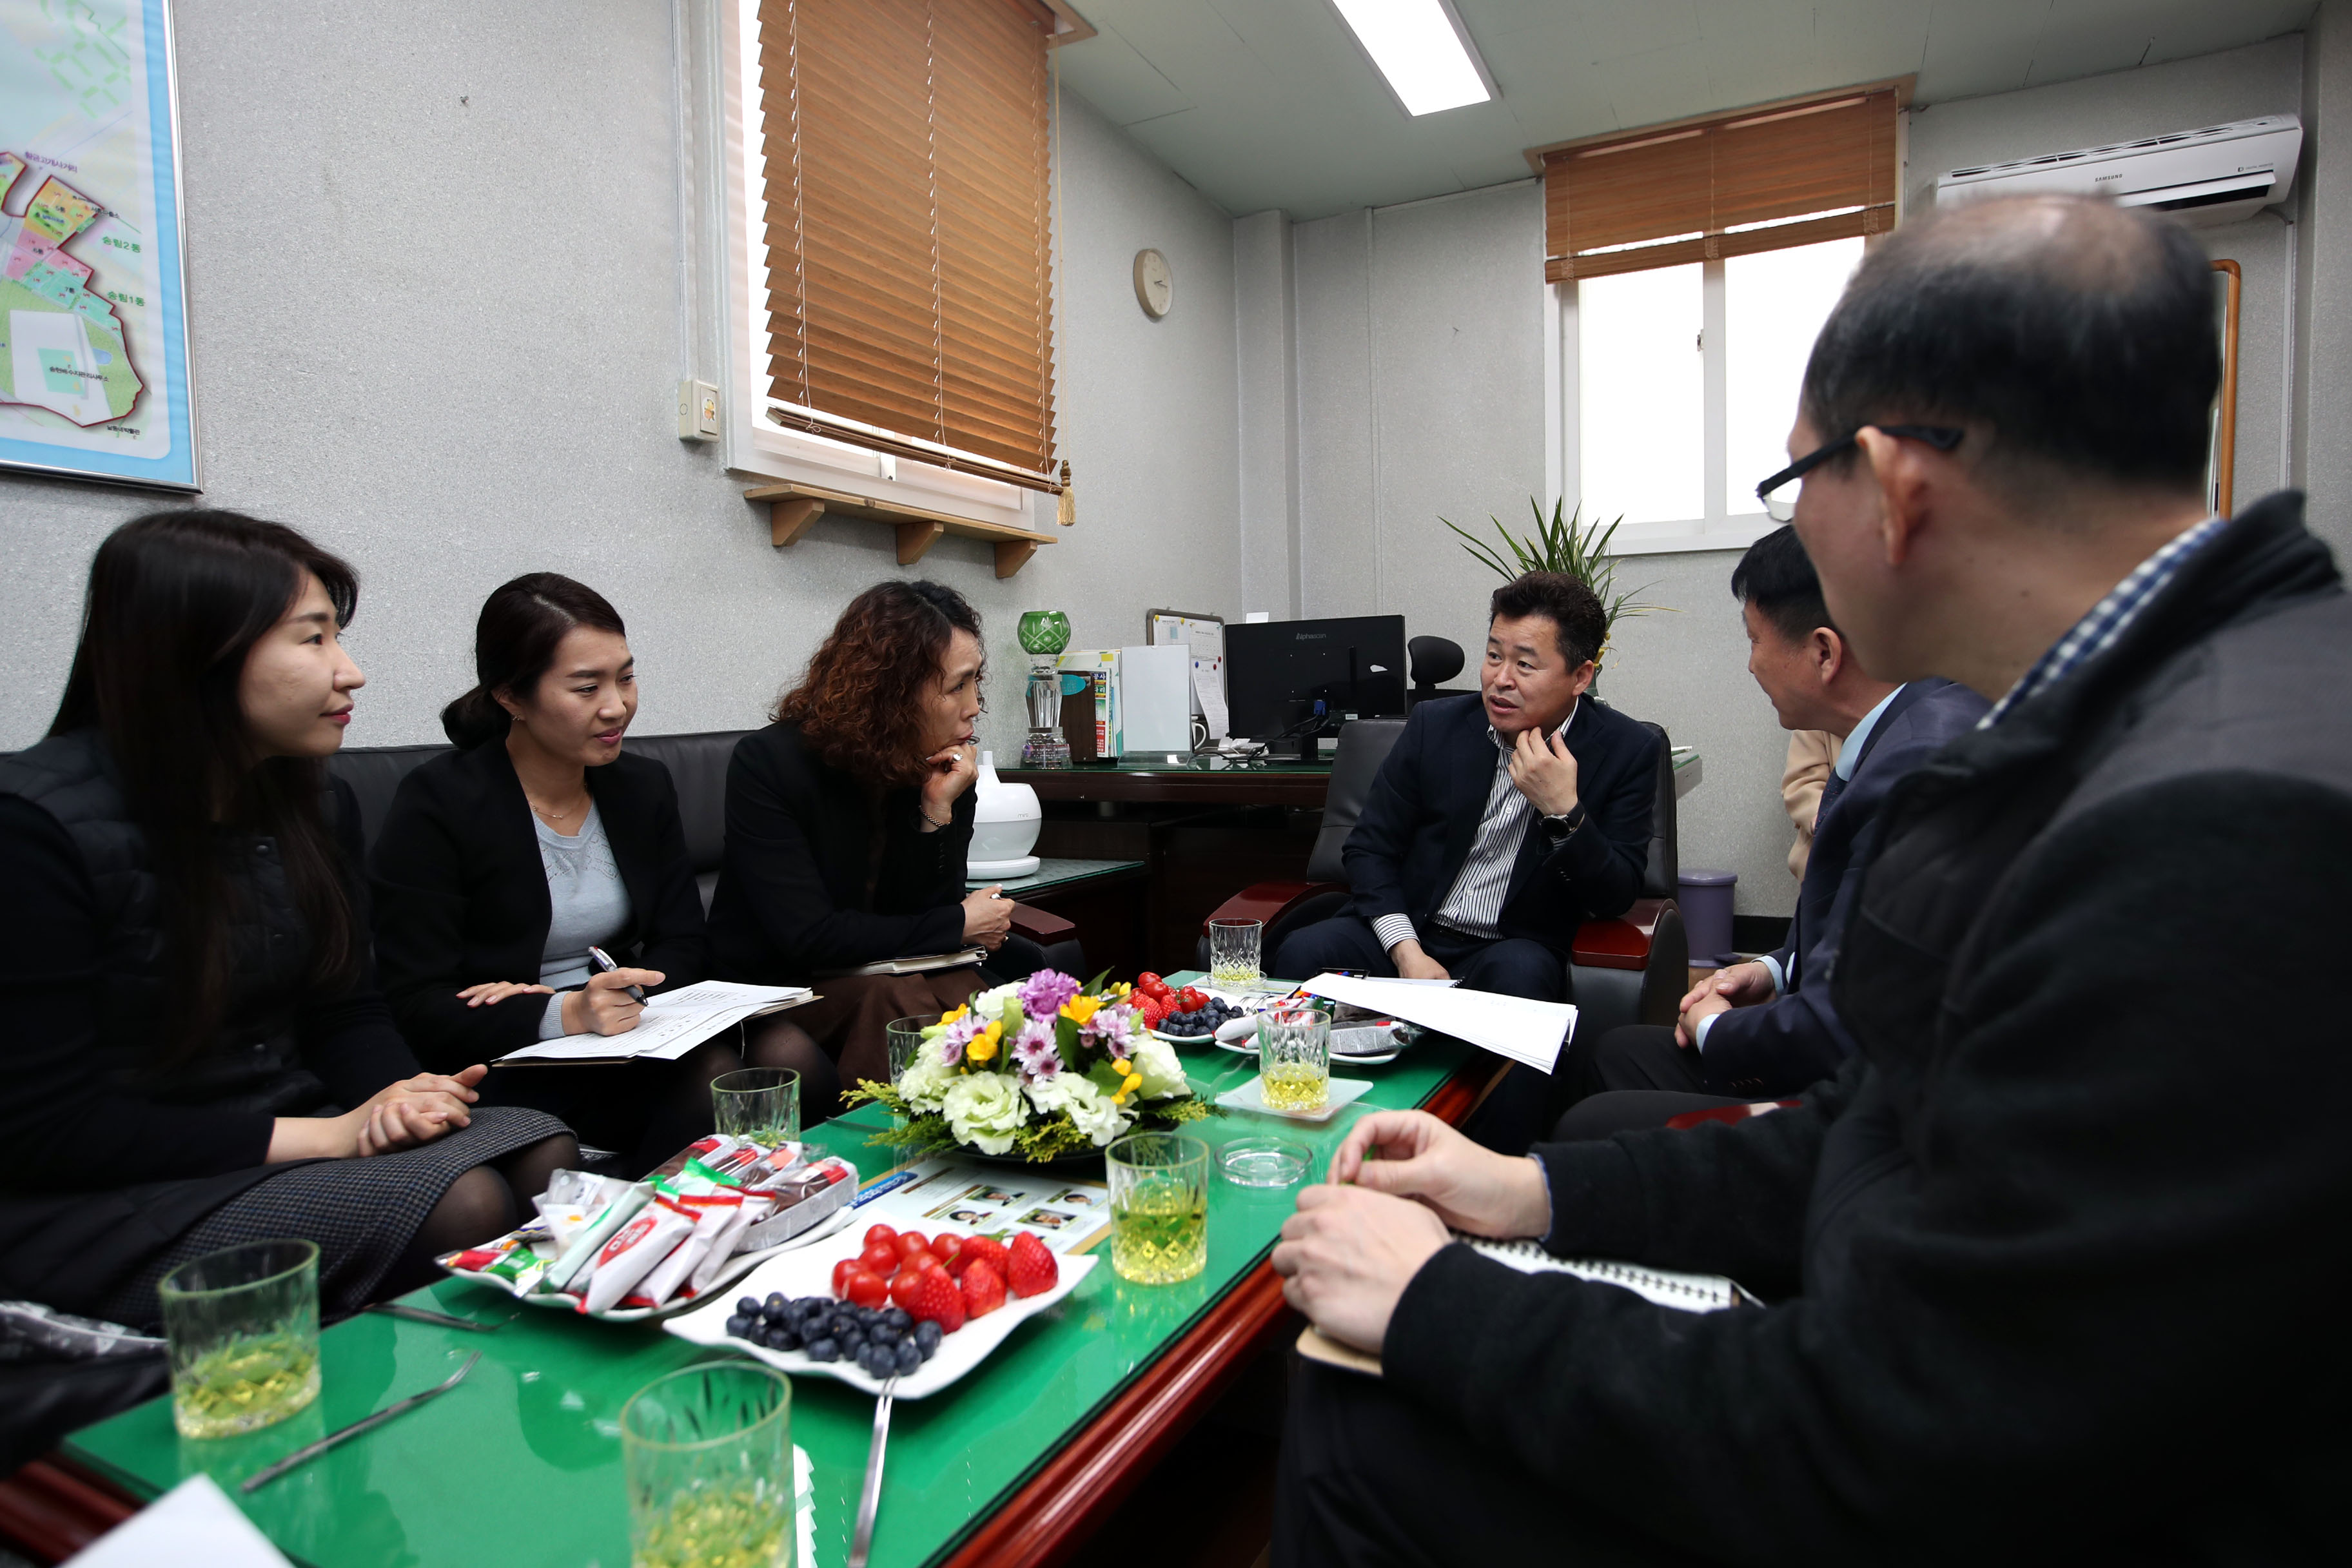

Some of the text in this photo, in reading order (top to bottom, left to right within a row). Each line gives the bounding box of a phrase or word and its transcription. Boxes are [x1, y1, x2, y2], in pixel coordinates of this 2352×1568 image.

[2095, 173, 2122, 182] SAMSUNG
[103, 236, 141, 253] 송림2동
[108, 291, 145, 306] 송림1동
